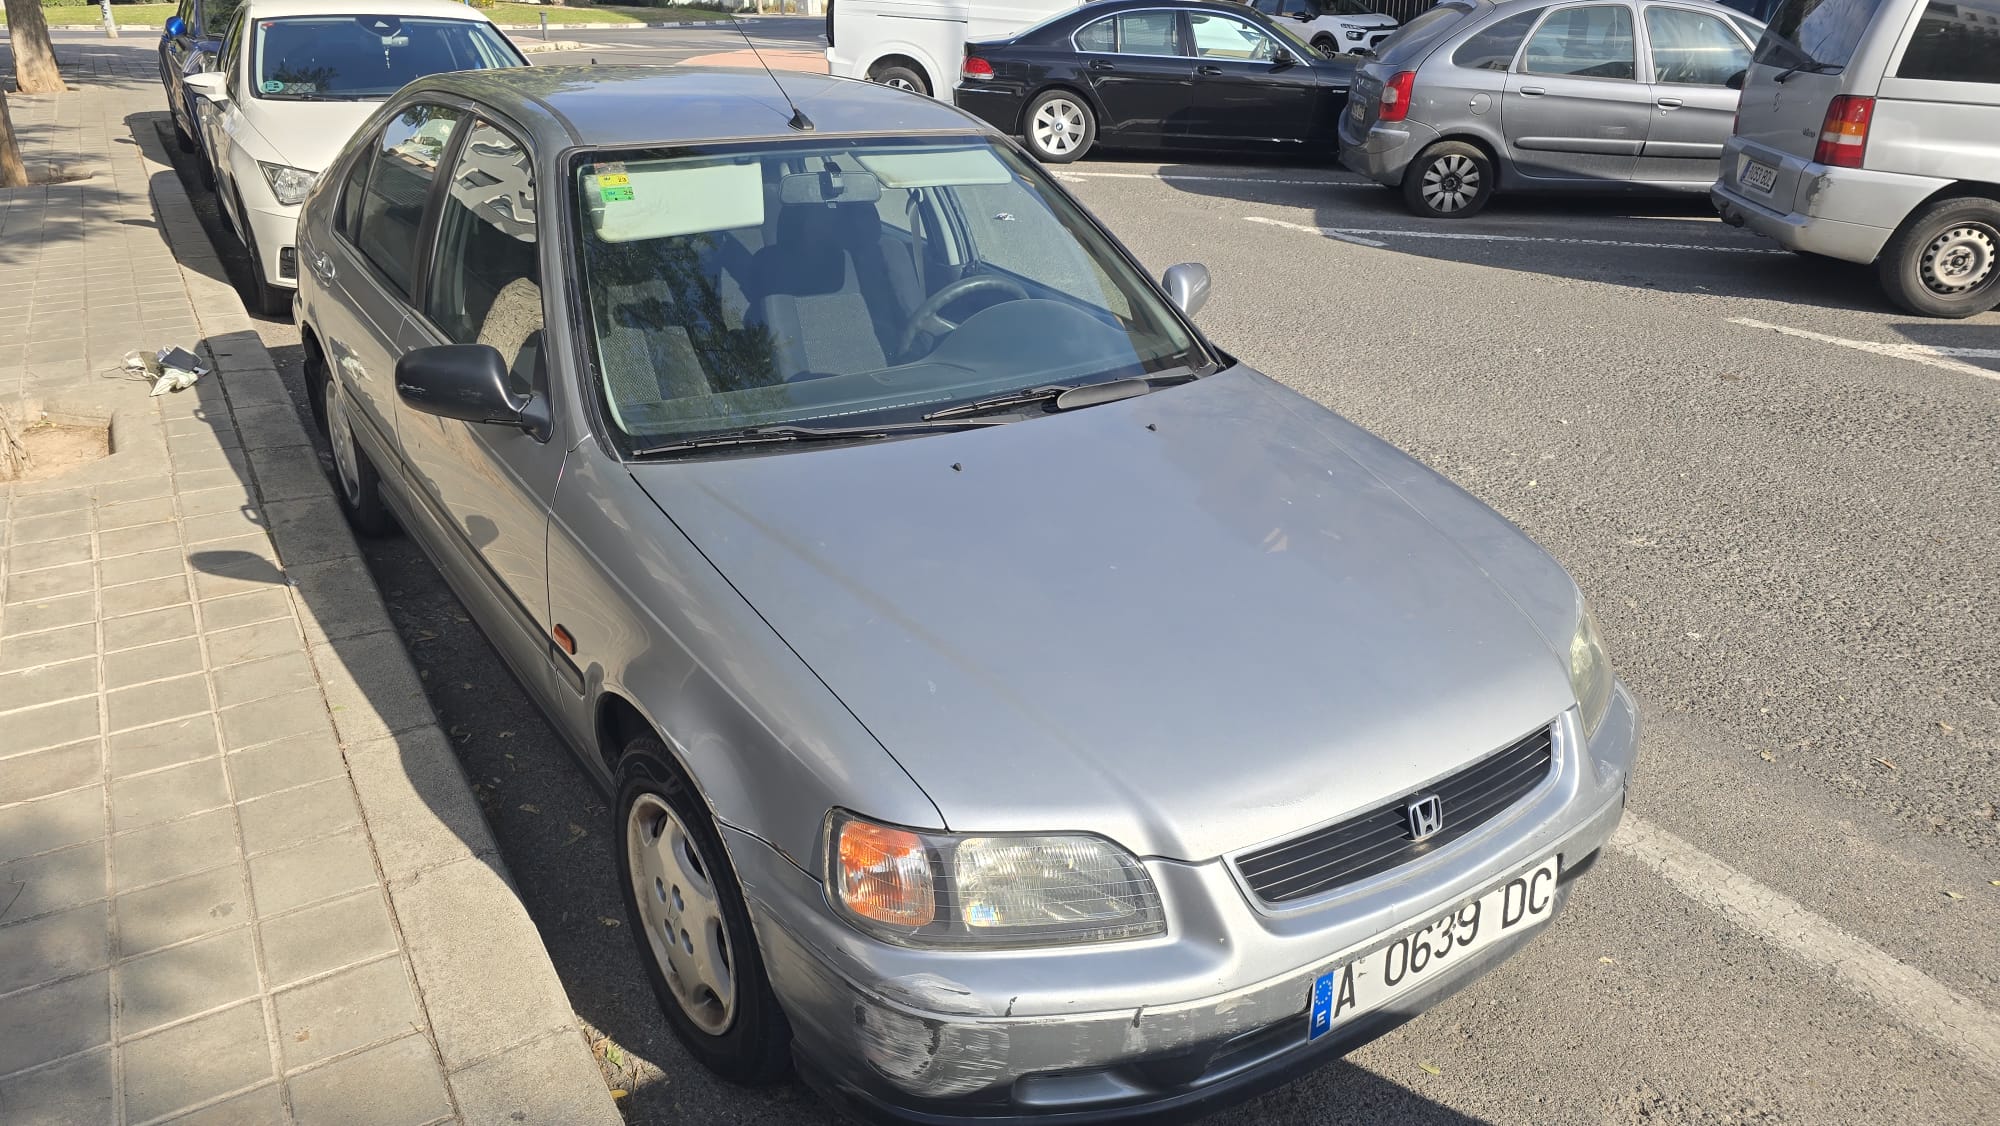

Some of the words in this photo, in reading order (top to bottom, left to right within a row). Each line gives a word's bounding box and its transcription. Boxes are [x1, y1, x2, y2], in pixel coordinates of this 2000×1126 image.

[1334, 962, 1356, 1019] A
[1384, 900, 1482, 987] 0639
[1502, 867, 1553, 930] DC
[1316, 1011, 1327, 1027] E
